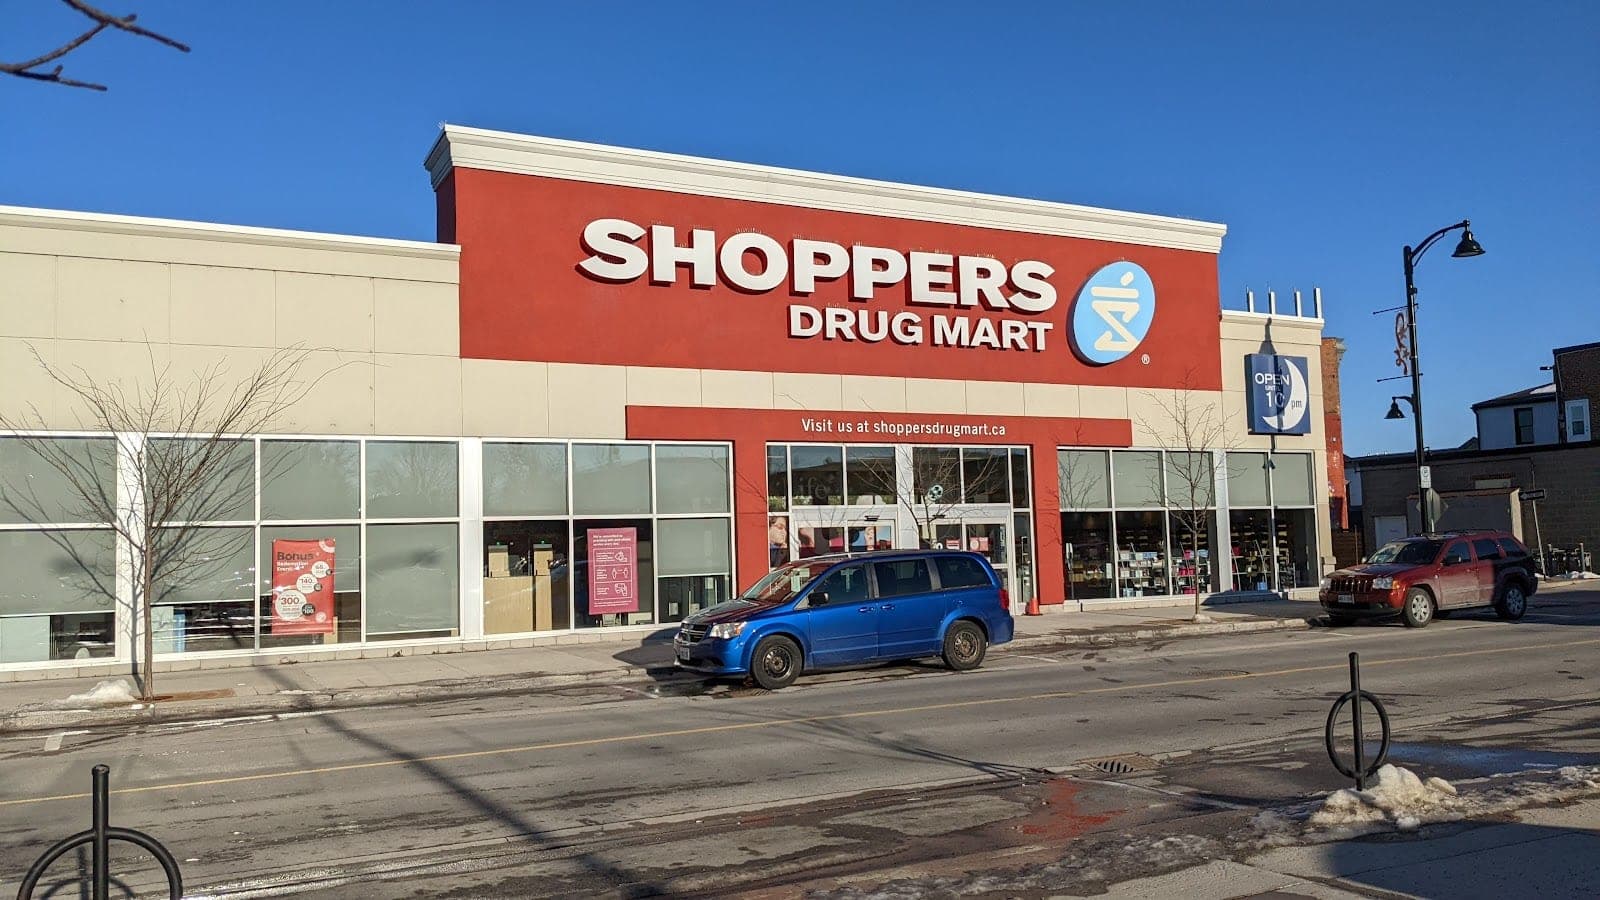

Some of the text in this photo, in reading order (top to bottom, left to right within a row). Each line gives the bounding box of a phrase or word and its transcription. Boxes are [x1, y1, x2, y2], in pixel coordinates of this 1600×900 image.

[580, 218, 1057, 312] SHOPPERS
[789, 304, 1053, 351] DRUG MART
[1254, 372, 1290, 386] OPEN
[1265, 391, 1285, 408] 10
[1291, 400, 1302, 409] pm
[801, 418, 1006, 437] Visit us at shoppersdrugmart.ca
[277, 552, 313, 561] Bonus
